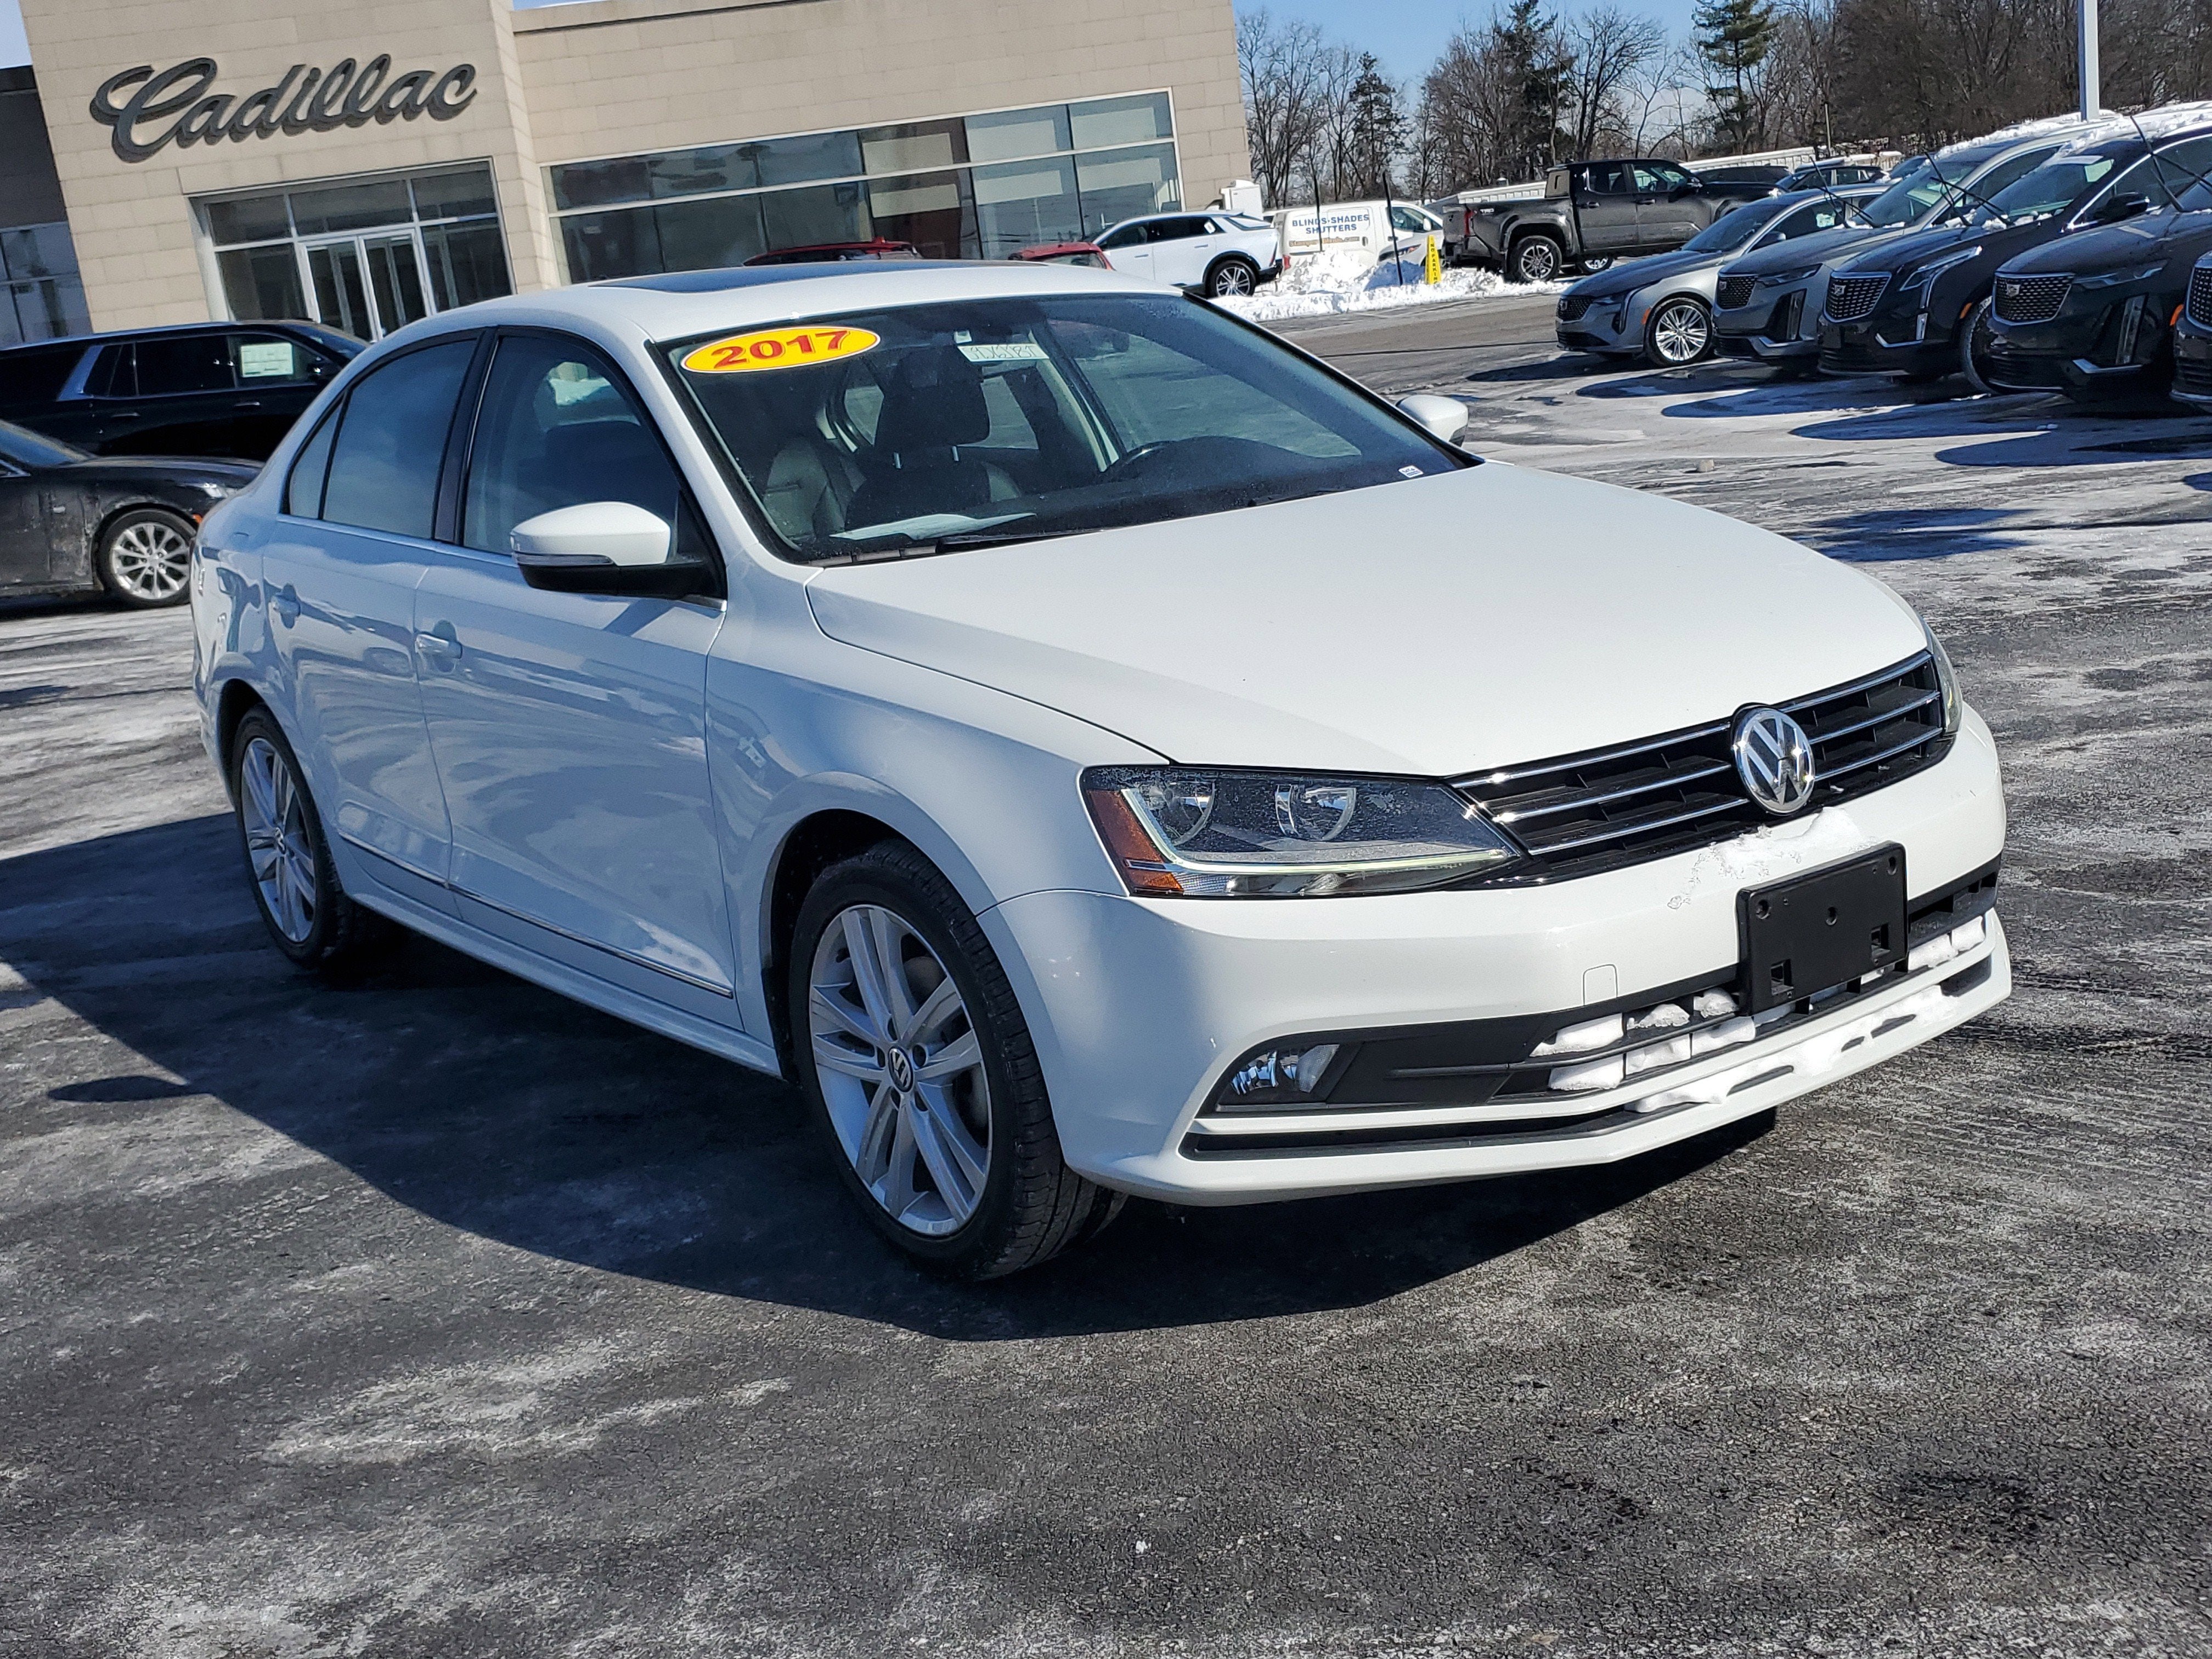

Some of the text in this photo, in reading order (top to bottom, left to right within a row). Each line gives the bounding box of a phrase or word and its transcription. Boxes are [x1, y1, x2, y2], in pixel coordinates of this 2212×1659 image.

[89, 54, 477, 163] Cadillac
[1306, 224, 1357, 234] SHUTTERS
[1431, 244, 1435, 252] NO
[711, 330, 850, 369] 2017
